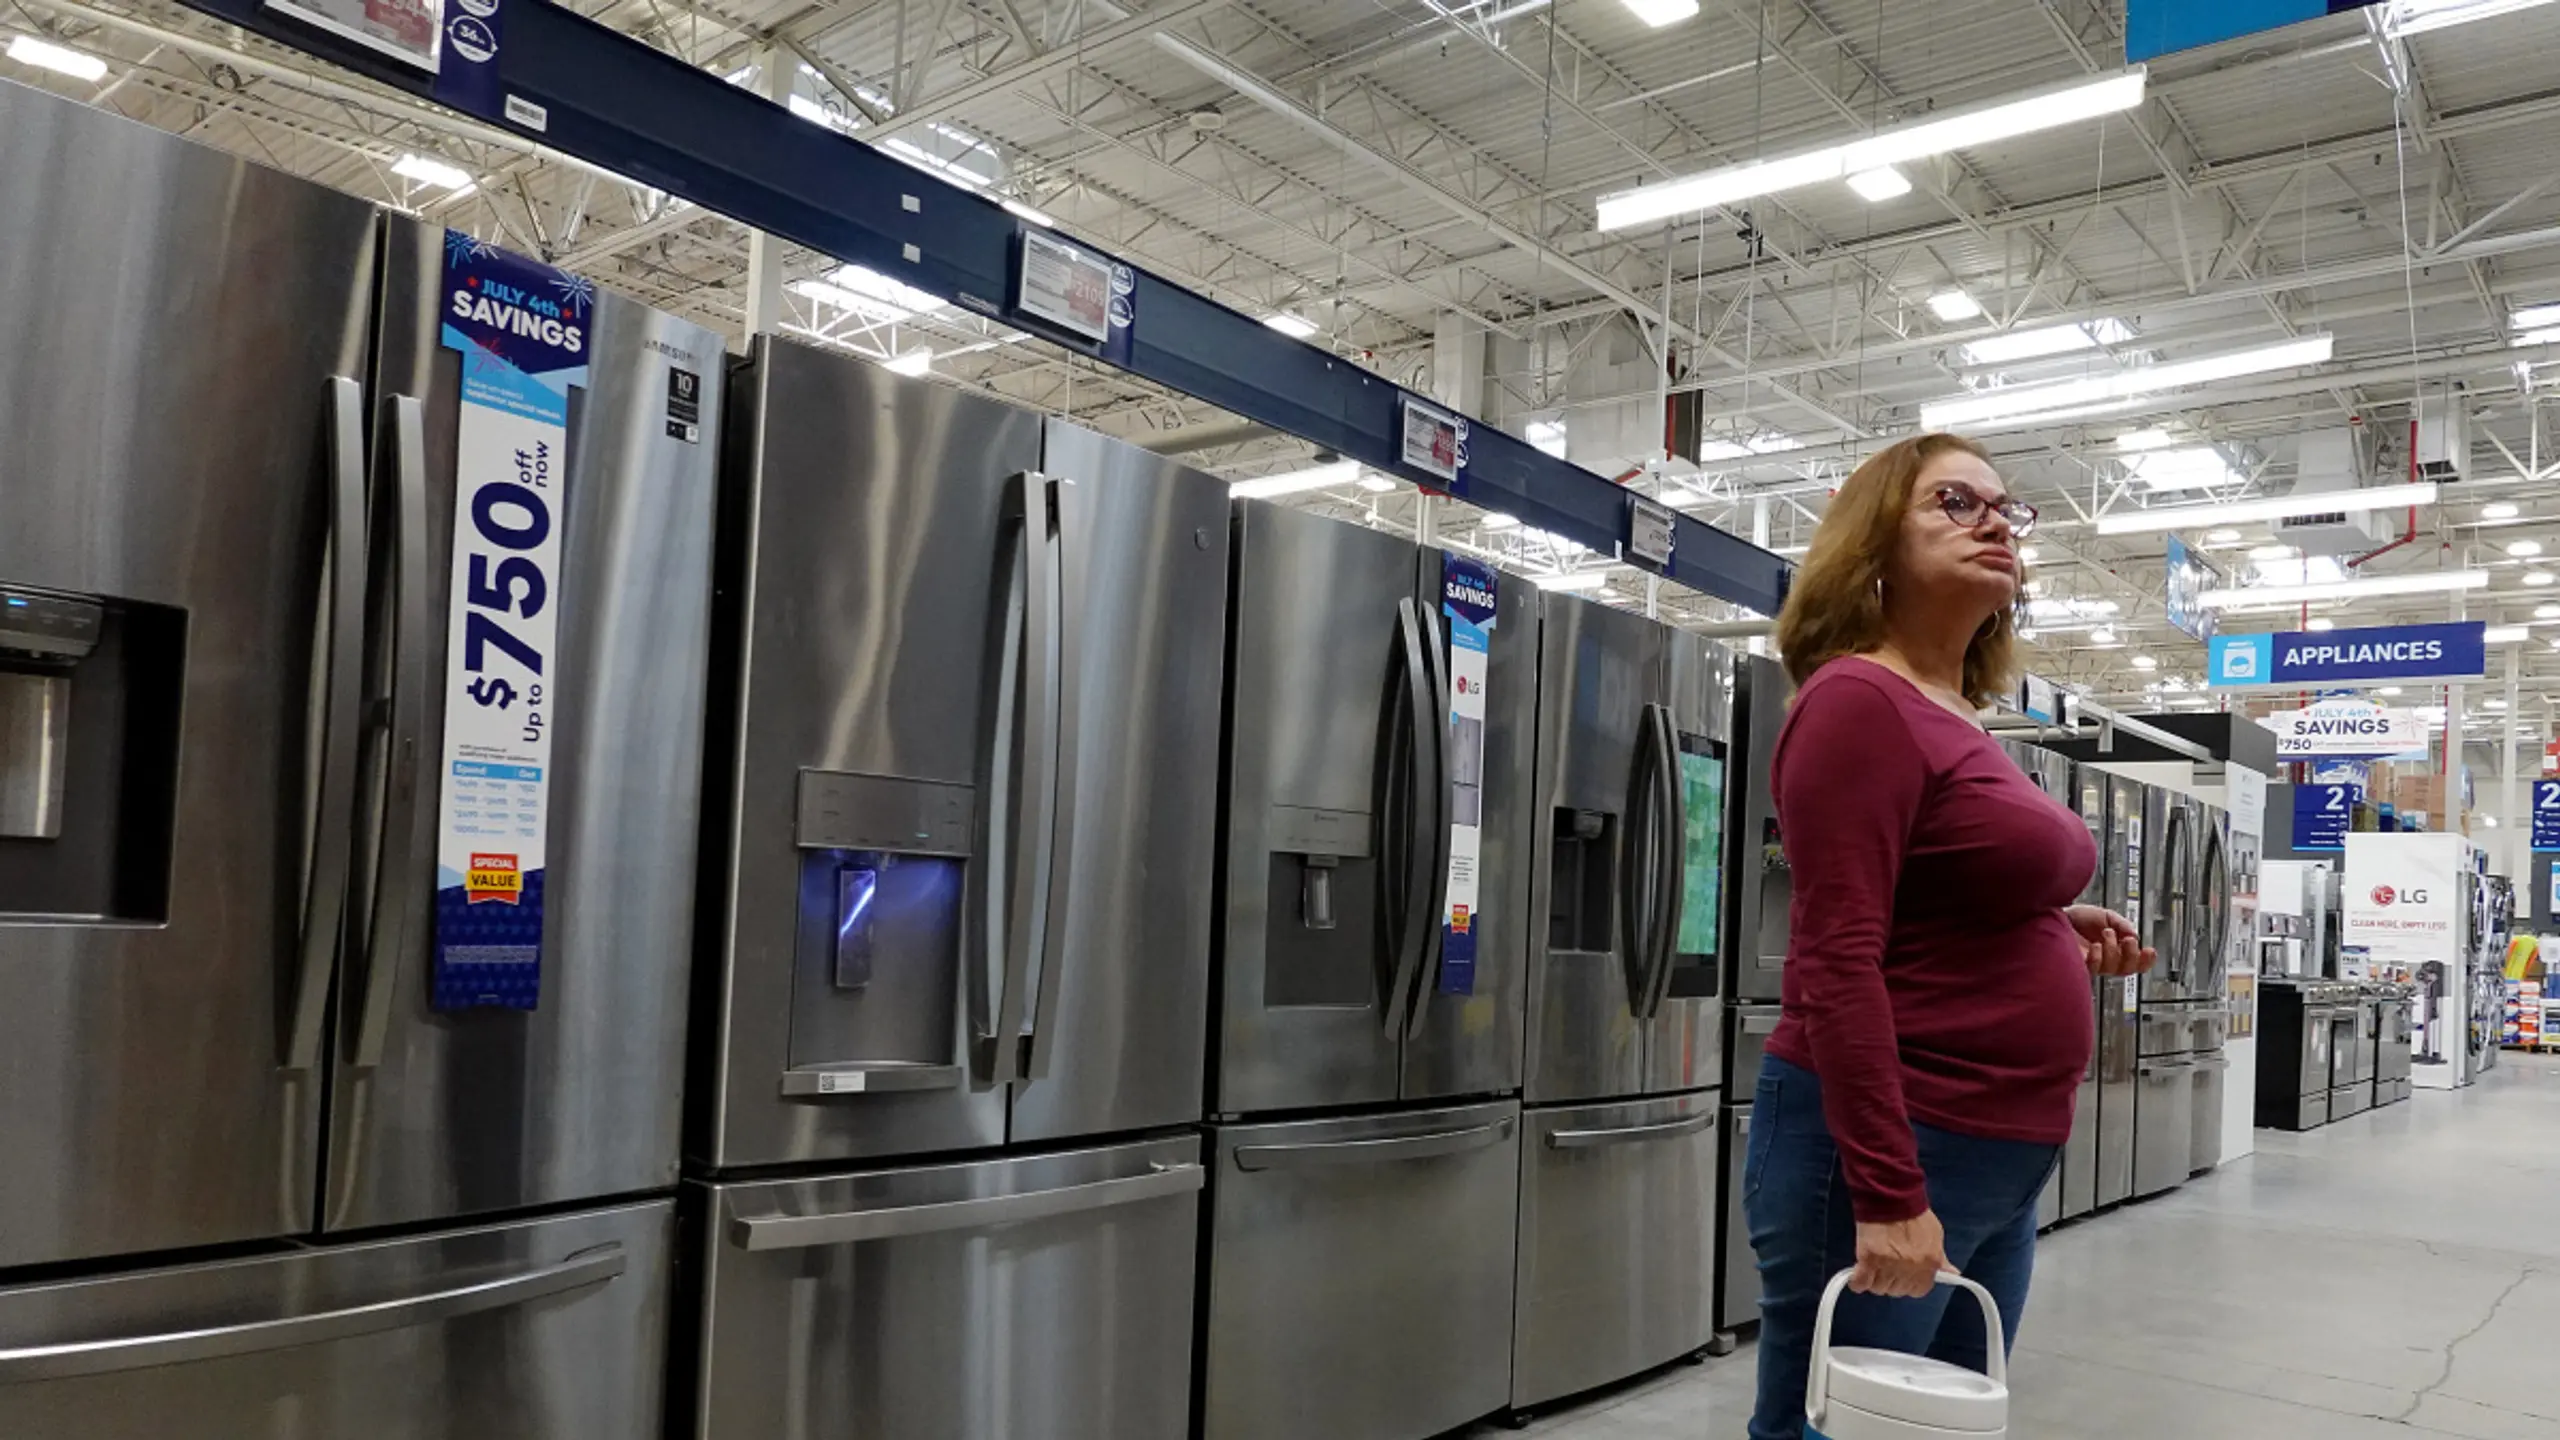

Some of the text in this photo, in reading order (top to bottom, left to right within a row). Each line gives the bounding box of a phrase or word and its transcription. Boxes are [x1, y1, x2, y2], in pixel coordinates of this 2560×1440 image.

[481, 279, 560, 318] JULY 4th
[452, 290, 582, 353] SAVINGS
[676, 373, 692, 392] 10
[515, 448, 531, 484] off
[534, 440, 550, 488] now
[464, 480, 551, 711] $750
[1446, 583, 1495, 609] SAVINGS
[2282, 640, 2442, 667] APPLIANCES
[1468, 682, 1480, 694] LG
[523, 683, 544, 742] Up to
[2313, 708, 2372, 718] JULY 4th
[2294, 719, 2390, 736] SAVINGS
[2278, 738, 2312, 750] $750
[2325, 786, 2345, 811] 2
[2352, 787, 2360, 801] 2
[2540, 783, 2560, 808] 2
[473, 857, 515, 869] SPECIAL
[471, 873, 516, 887] VALUE
[2400, 889, 2428, 904] LG
